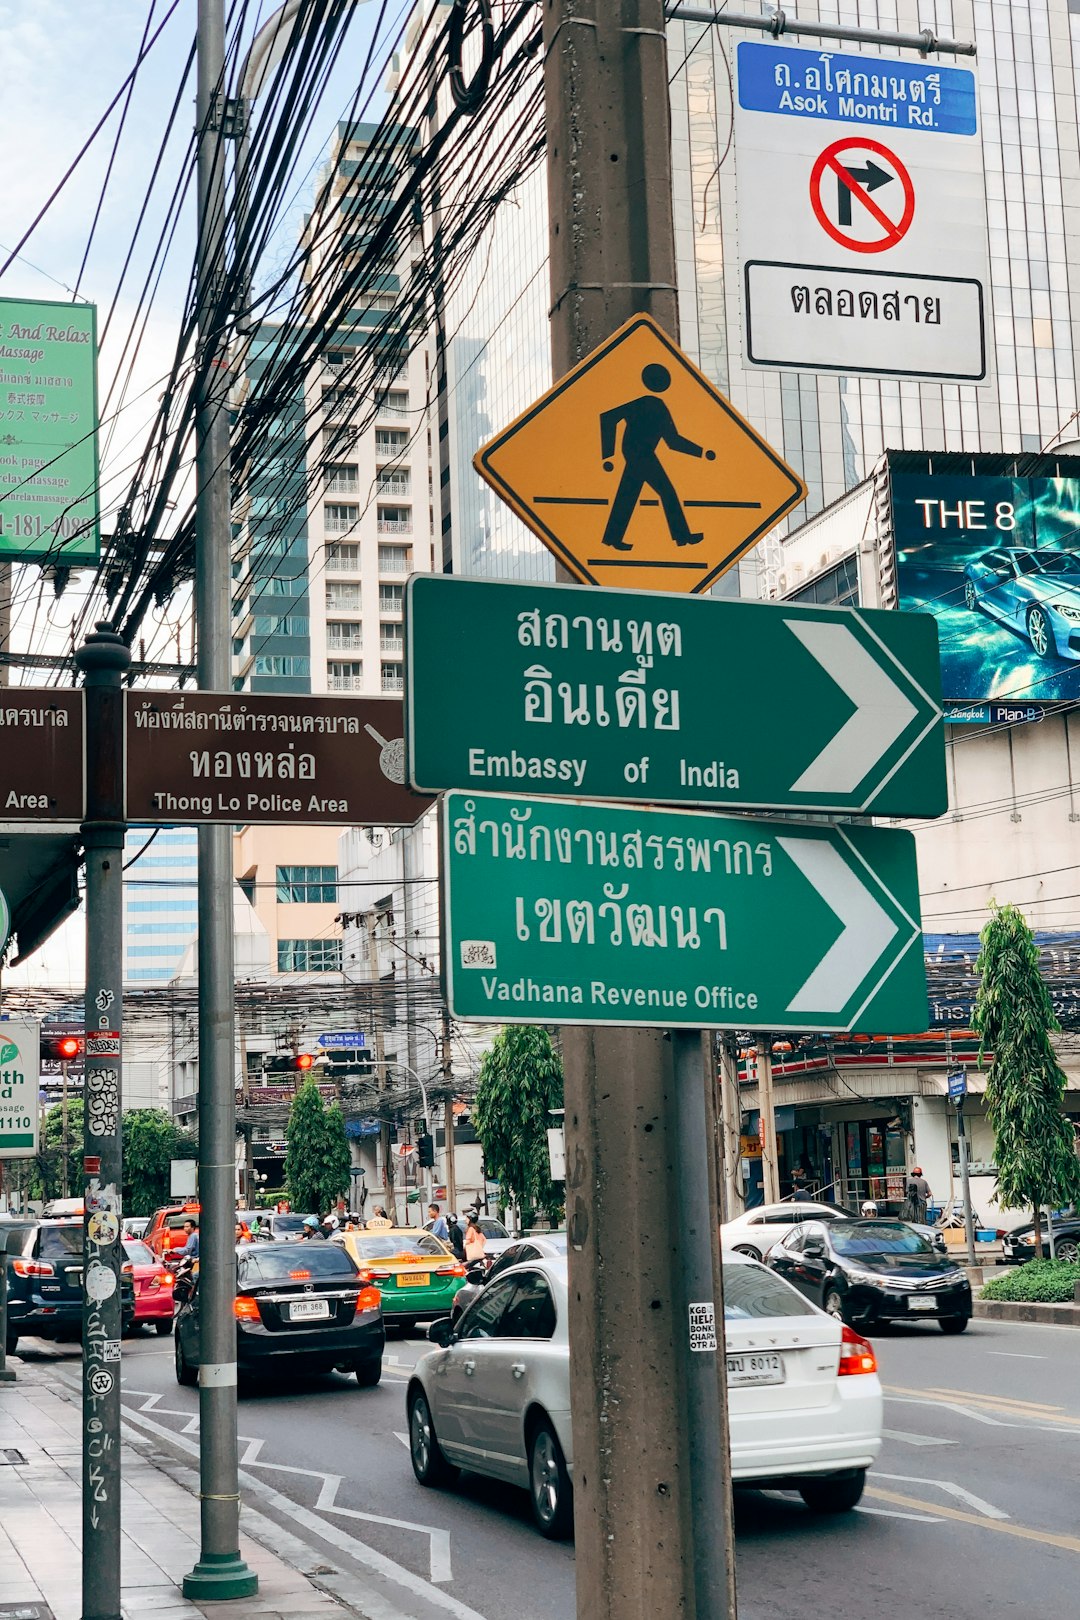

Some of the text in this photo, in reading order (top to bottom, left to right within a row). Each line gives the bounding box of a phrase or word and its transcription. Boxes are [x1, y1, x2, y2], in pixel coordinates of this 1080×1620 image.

[774, 54, 941, 105] ถ.อโศกมนตรี
[779, 91, 939, 127] Asok Montri Rd.
[790, 283, 941, 325] ตลอดสาย
[7, 324, 44, 340] And
[45, 326, 90, 343] Relax
[32, 411, 79, 424] マッサージ
[22, 458, 46, 468] page
[26, 477, 70, 487] massage
[915, 499, 1016, 531] THE 8
[516, 607, 683, 667] สถานทูต
[523, 663, 681, 731] อินเดีย
[997, 708, 1023, 720] Plan
[134, 697, 360, 735] ท้องที่สถานีตำรวจนครบาล
[189, 743, 316, 780] ทองหล่อ
[468, 748, 740, 789] Embassy of India
[6, 790, 48, 809] Area
[154, 792, 348, 815] Thong Lo Police Area
[454, 800, 773, 877] สำนักงานสรรพากร
[515, 882, 728, 950] เขตวัฒนา
[481, 976, 759, 1010] Vadhana Revenue Office
[691, 1314, 713, 1324] HELP
[751, 1356, 778, 1370] 8012
